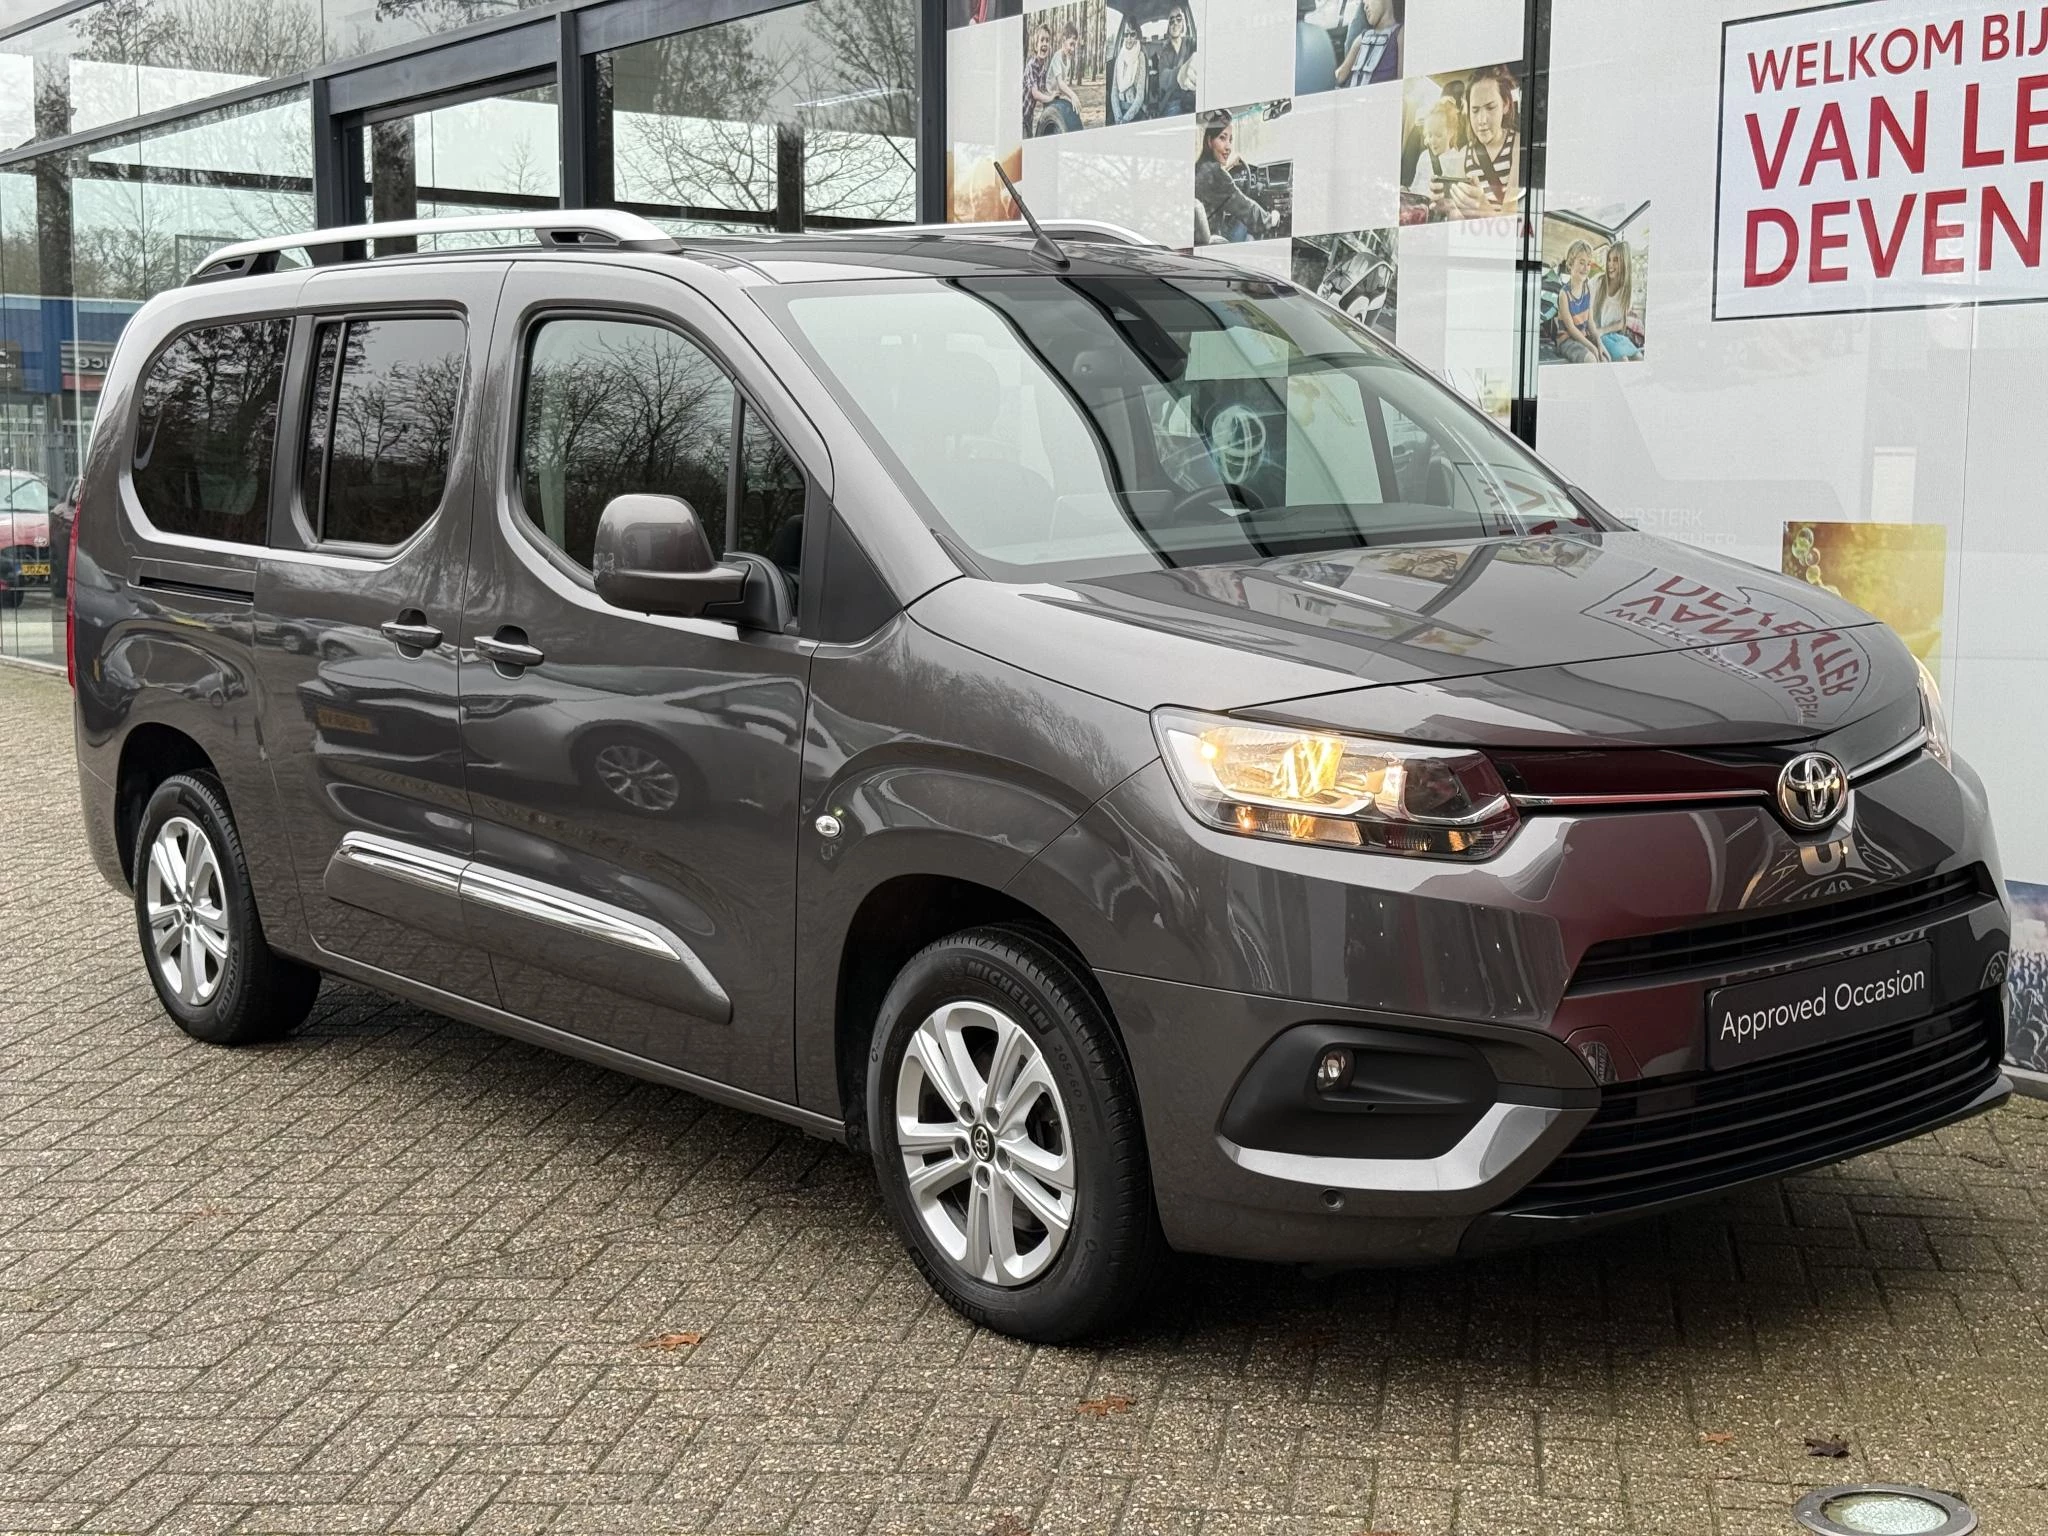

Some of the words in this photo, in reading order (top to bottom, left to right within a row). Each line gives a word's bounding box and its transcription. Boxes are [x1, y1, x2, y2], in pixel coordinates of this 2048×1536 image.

[1747, 19, 1963, 94] WELKOM
[1982, 6, 2048, 62] BIJ
[1744, 89, 1928, 190] VAN
[1744, 181, 2044, 288] DEVEN
[966, 961, 1049, 1031] MICHELIN
[1720, 987, 1827, 1043] Approved
[1834, 969, 1925, 1011] Occasion
